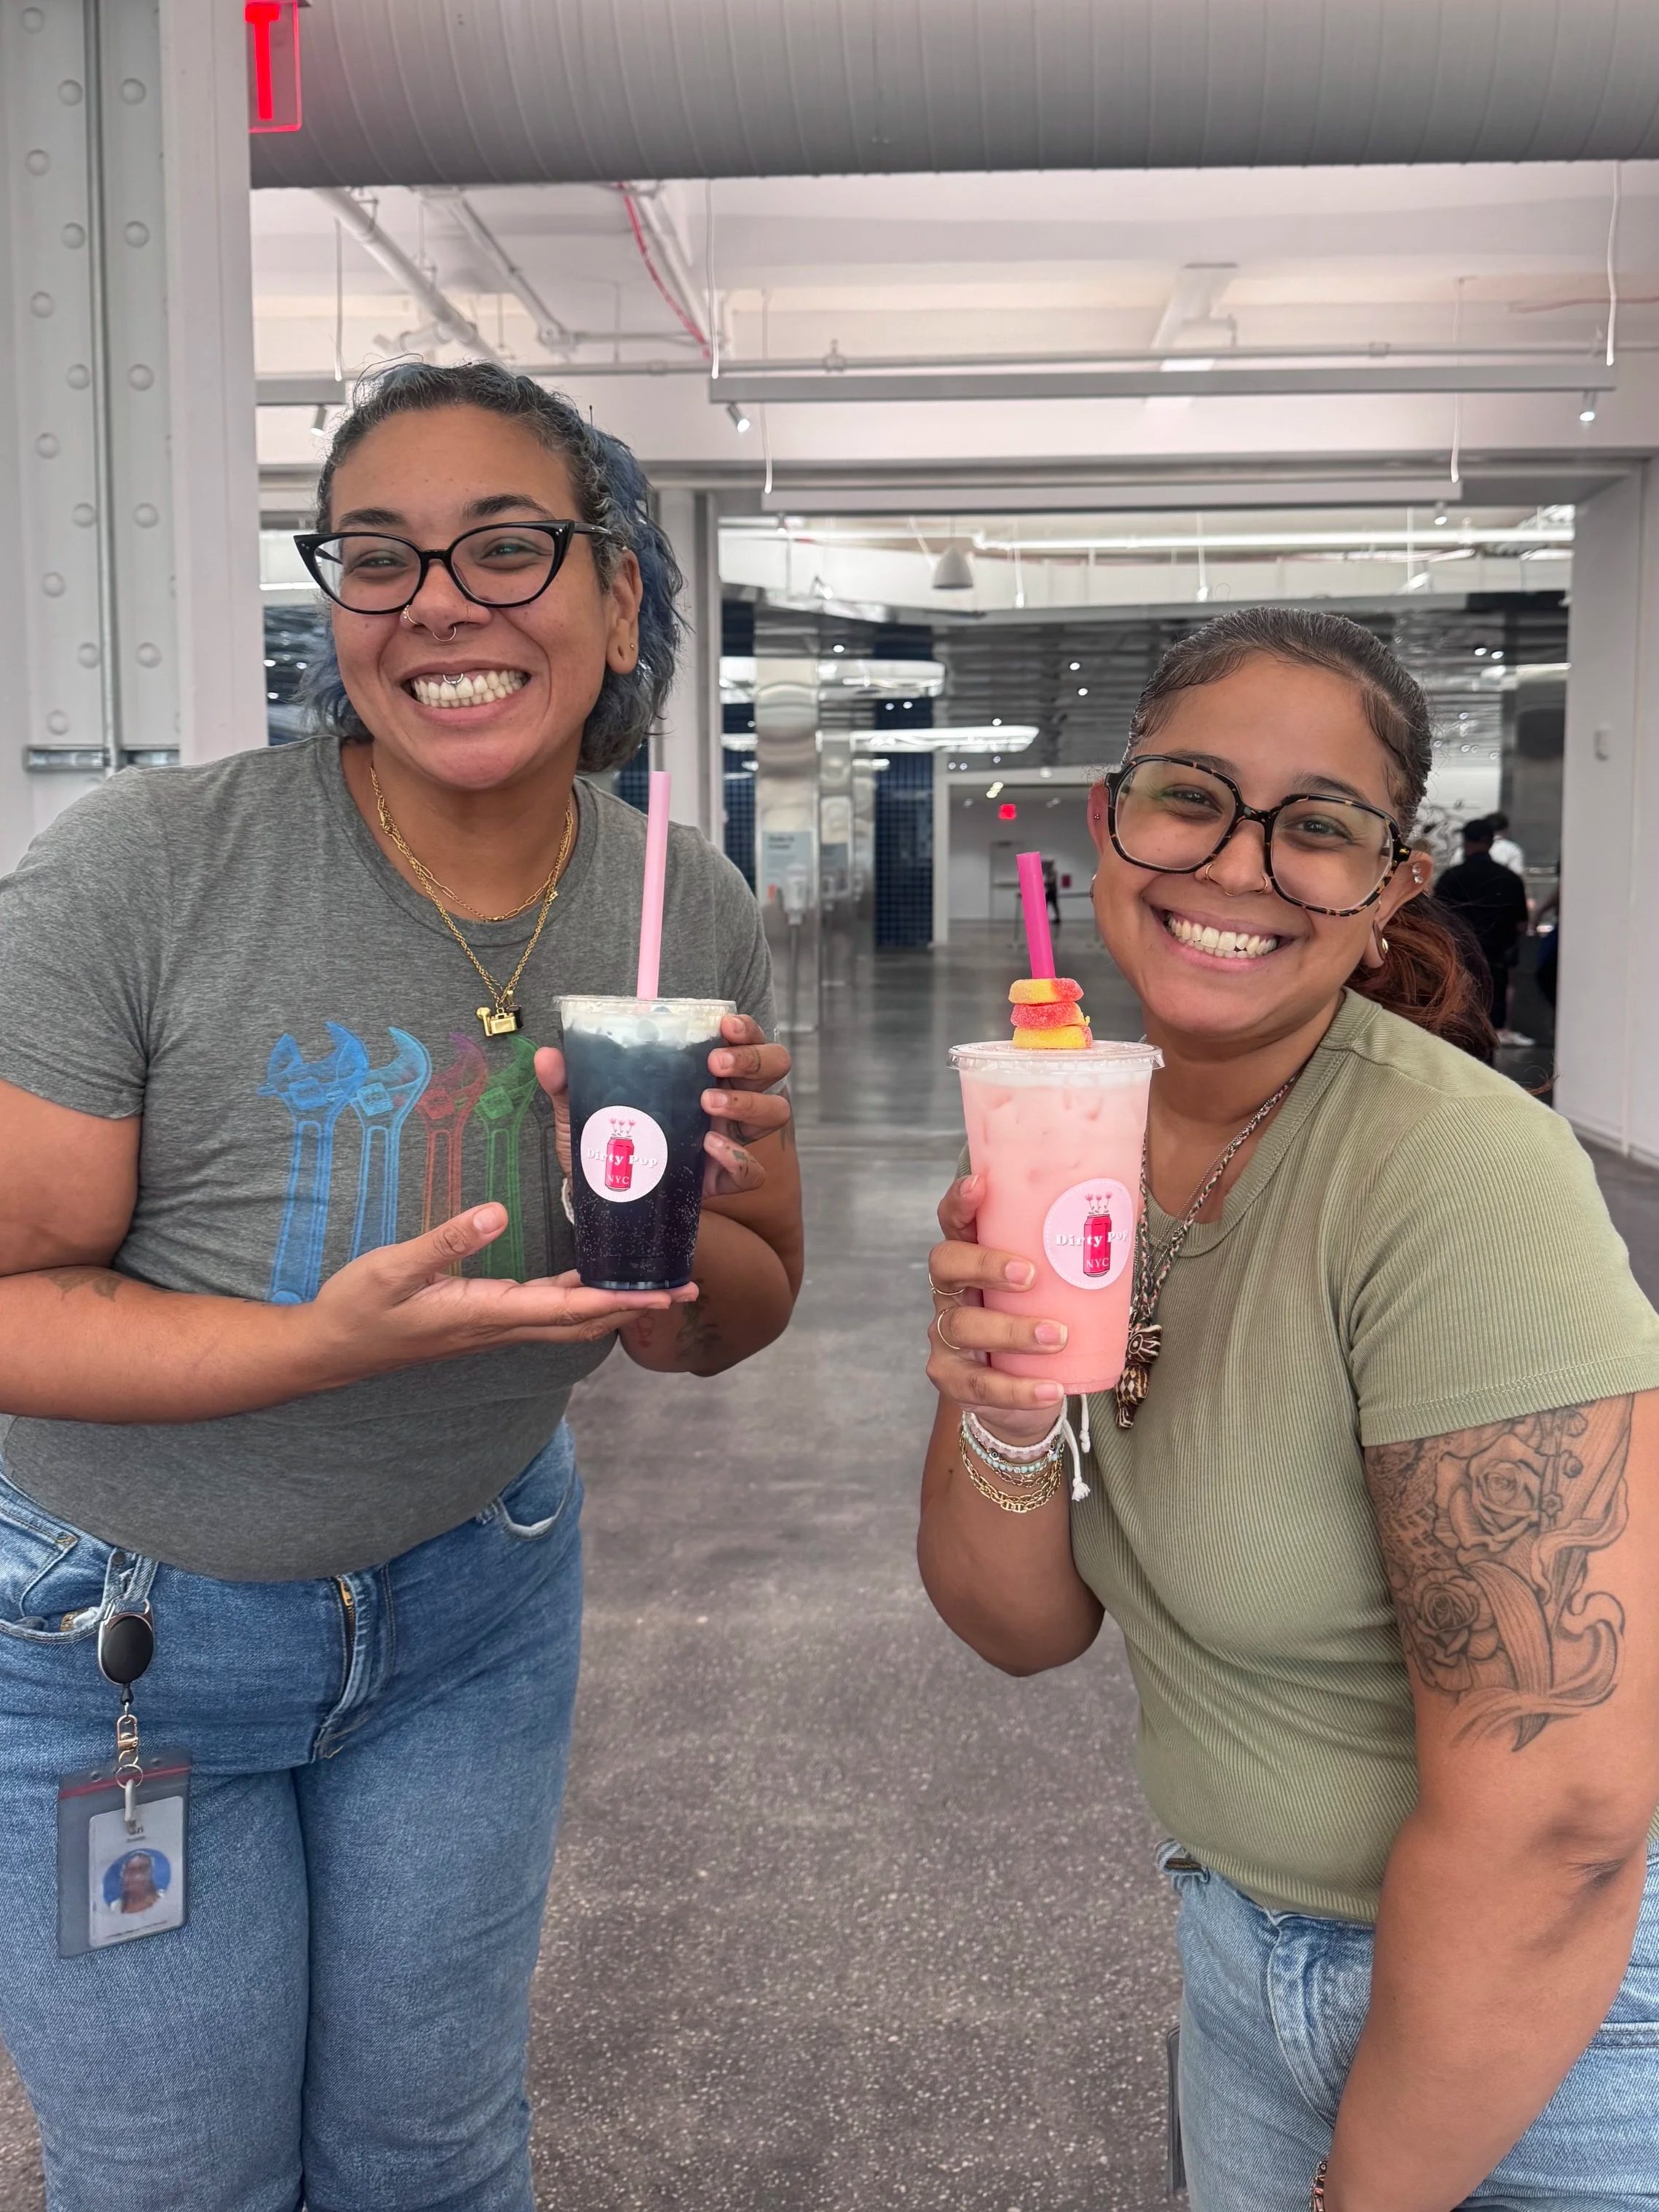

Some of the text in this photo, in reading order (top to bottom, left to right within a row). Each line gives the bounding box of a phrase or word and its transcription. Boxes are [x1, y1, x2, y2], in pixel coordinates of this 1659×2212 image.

[587, 1148, 659, 1168] Dirty Pop
[607, 1174, 630, 1185] NYC
[1056, 1234, 1102, 1247] Dirty
[1086, 1258, 1110, 1268] NYC
